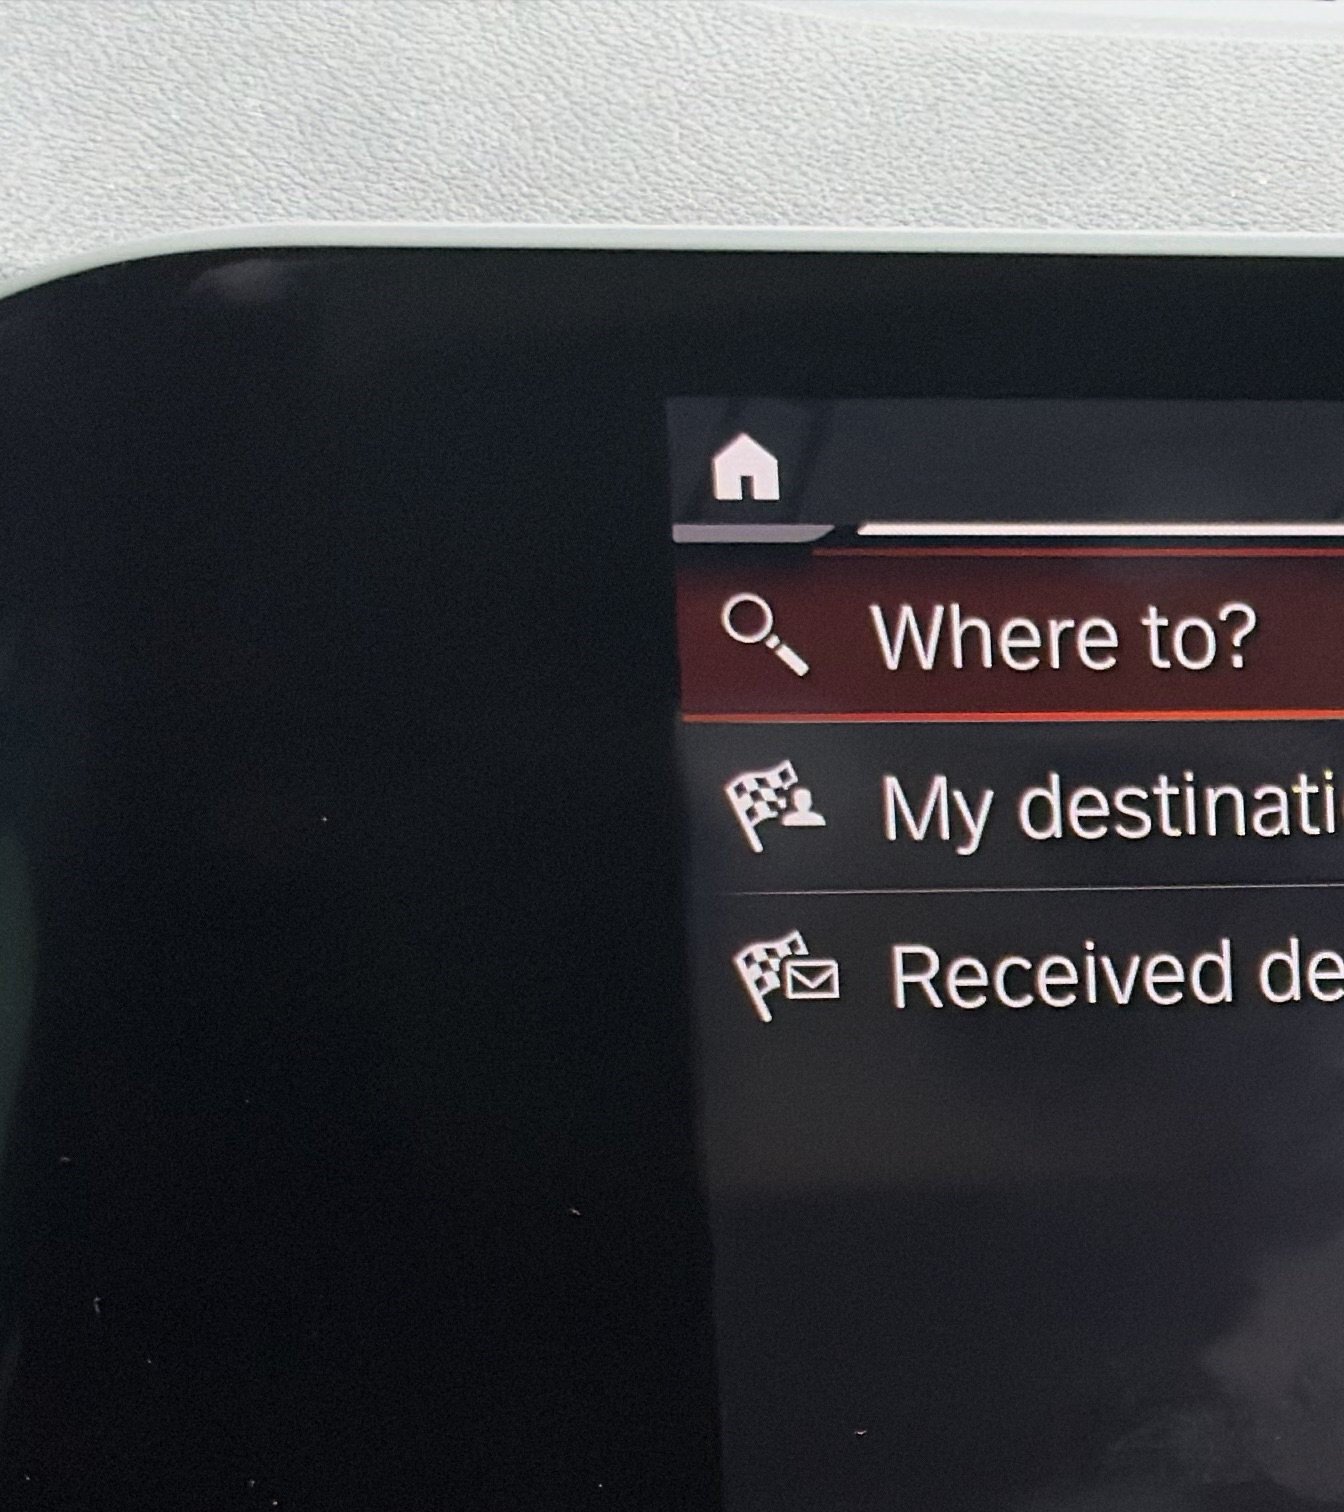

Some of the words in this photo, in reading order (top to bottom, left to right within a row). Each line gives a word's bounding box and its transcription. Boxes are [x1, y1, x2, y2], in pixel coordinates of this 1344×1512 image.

[869, 603, 1118, 672] Where
[1142, 602, 1258, 670] to?
[884, 775, 994, 855] My
[893, 939, 1233, 1011] Received
